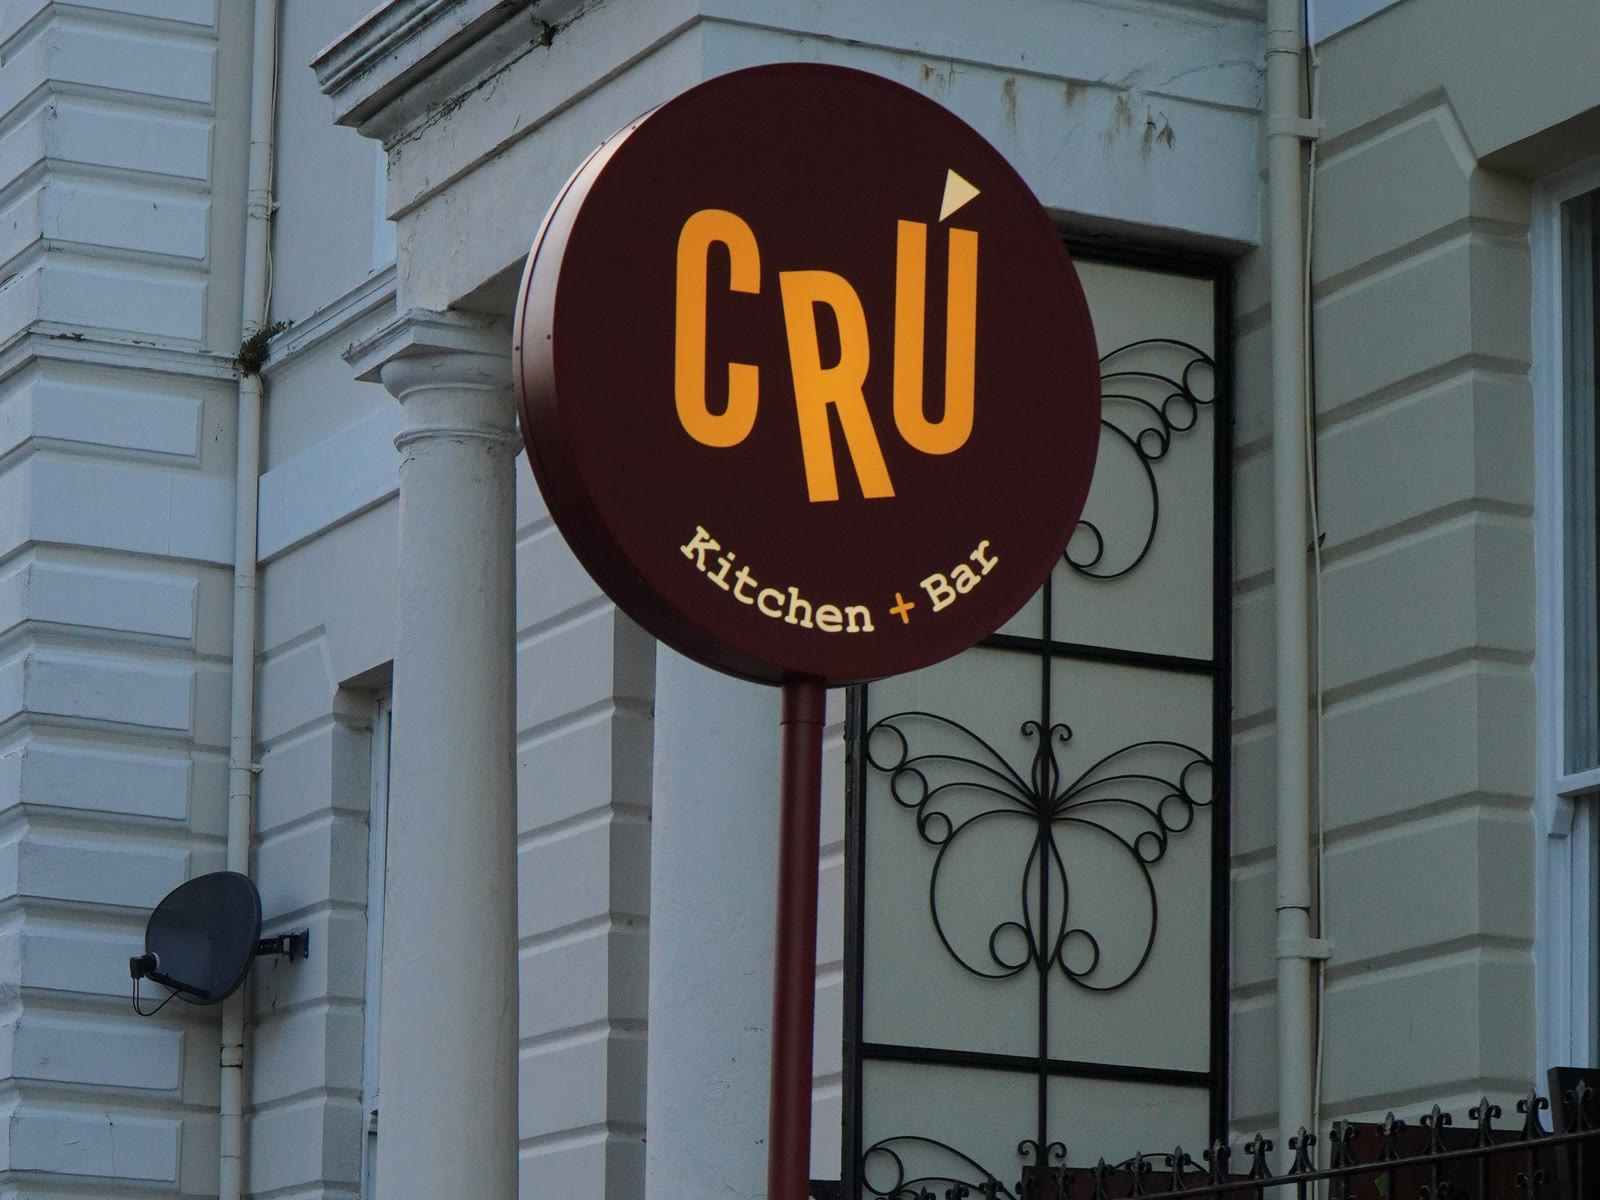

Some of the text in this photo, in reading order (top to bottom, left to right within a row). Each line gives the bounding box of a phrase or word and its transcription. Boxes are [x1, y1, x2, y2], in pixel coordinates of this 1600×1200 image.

[680, 525, 999, 633] Kitchen + Bar
